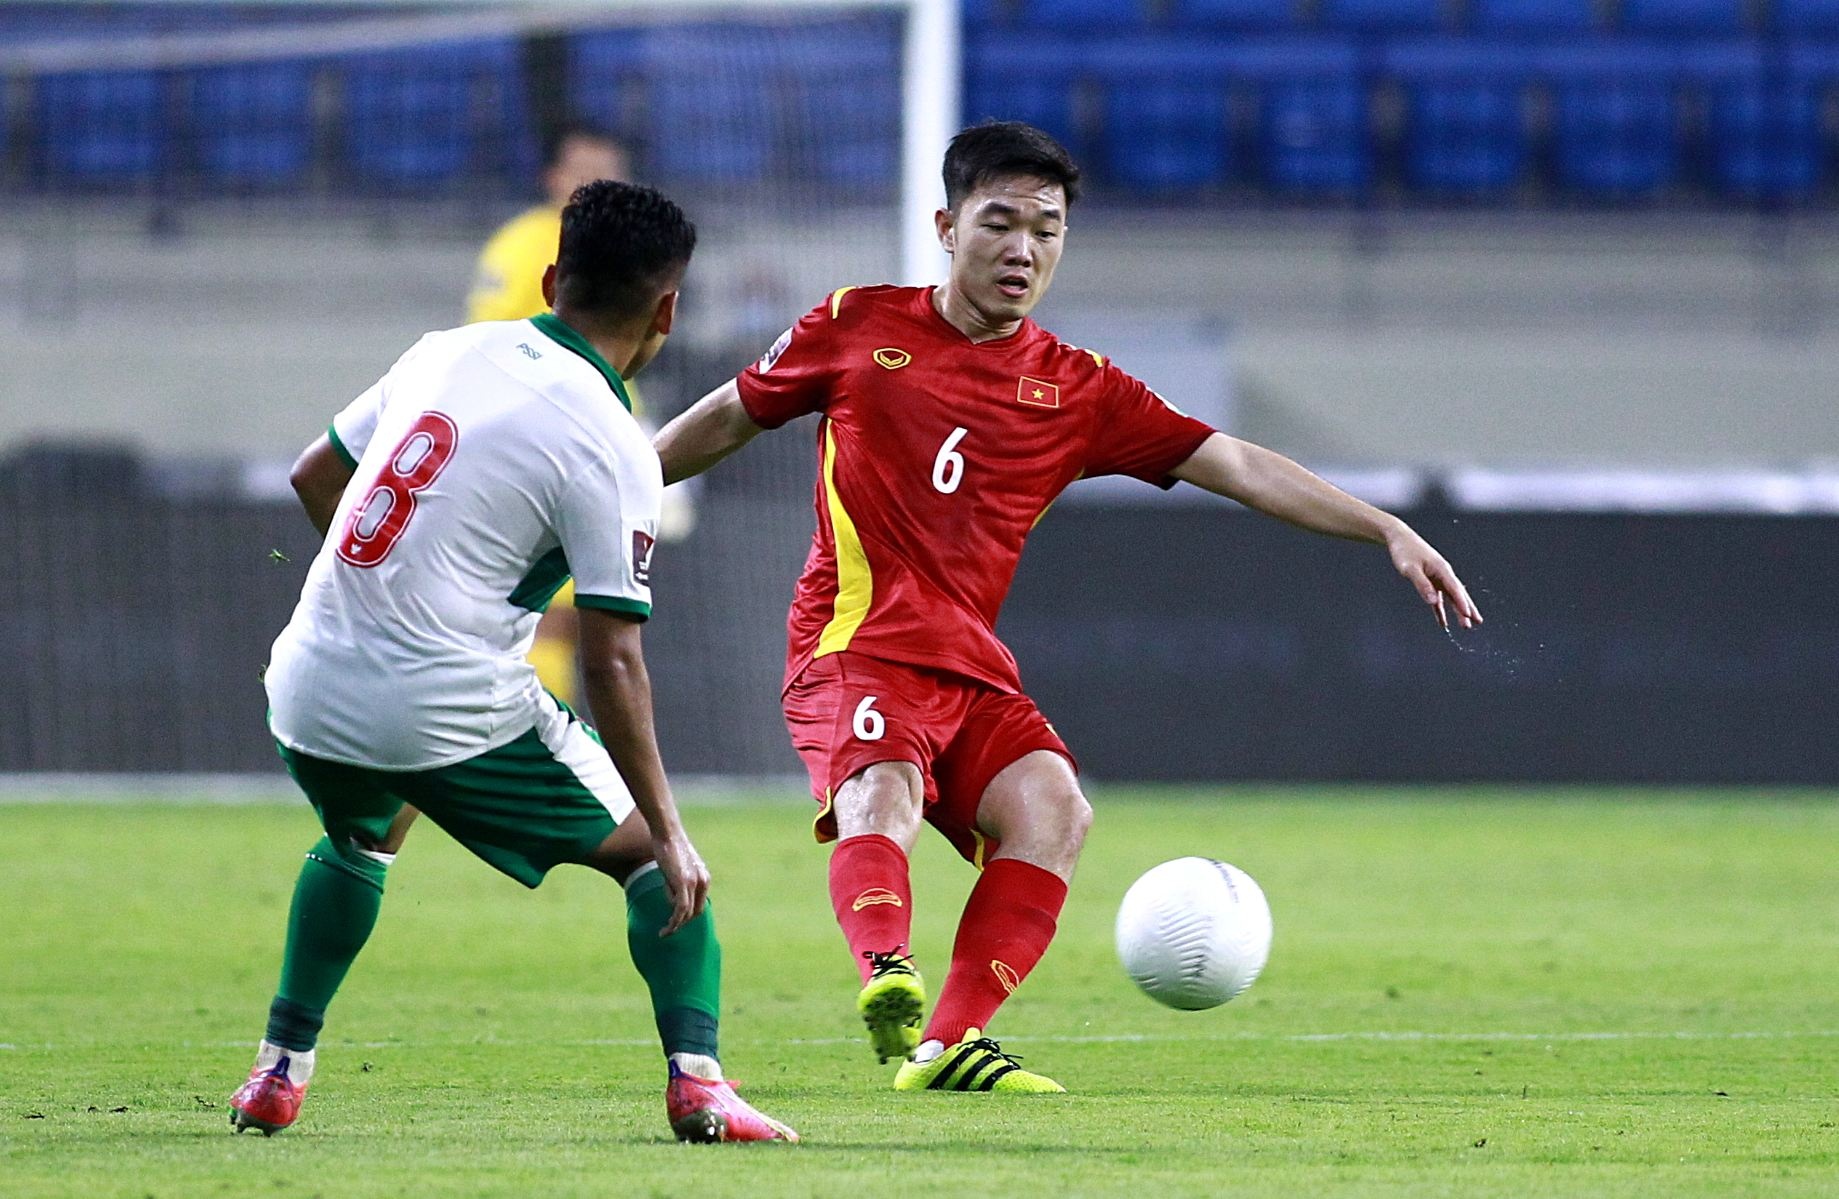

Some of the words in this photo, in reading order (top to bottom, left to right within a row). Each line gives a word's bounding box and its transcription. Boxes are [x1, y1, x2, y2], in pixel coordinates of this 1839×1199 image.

[336, 411, 459, 568] 8
[932, 426, 969, 494] 6
[852, 695, 885, 740] 6
